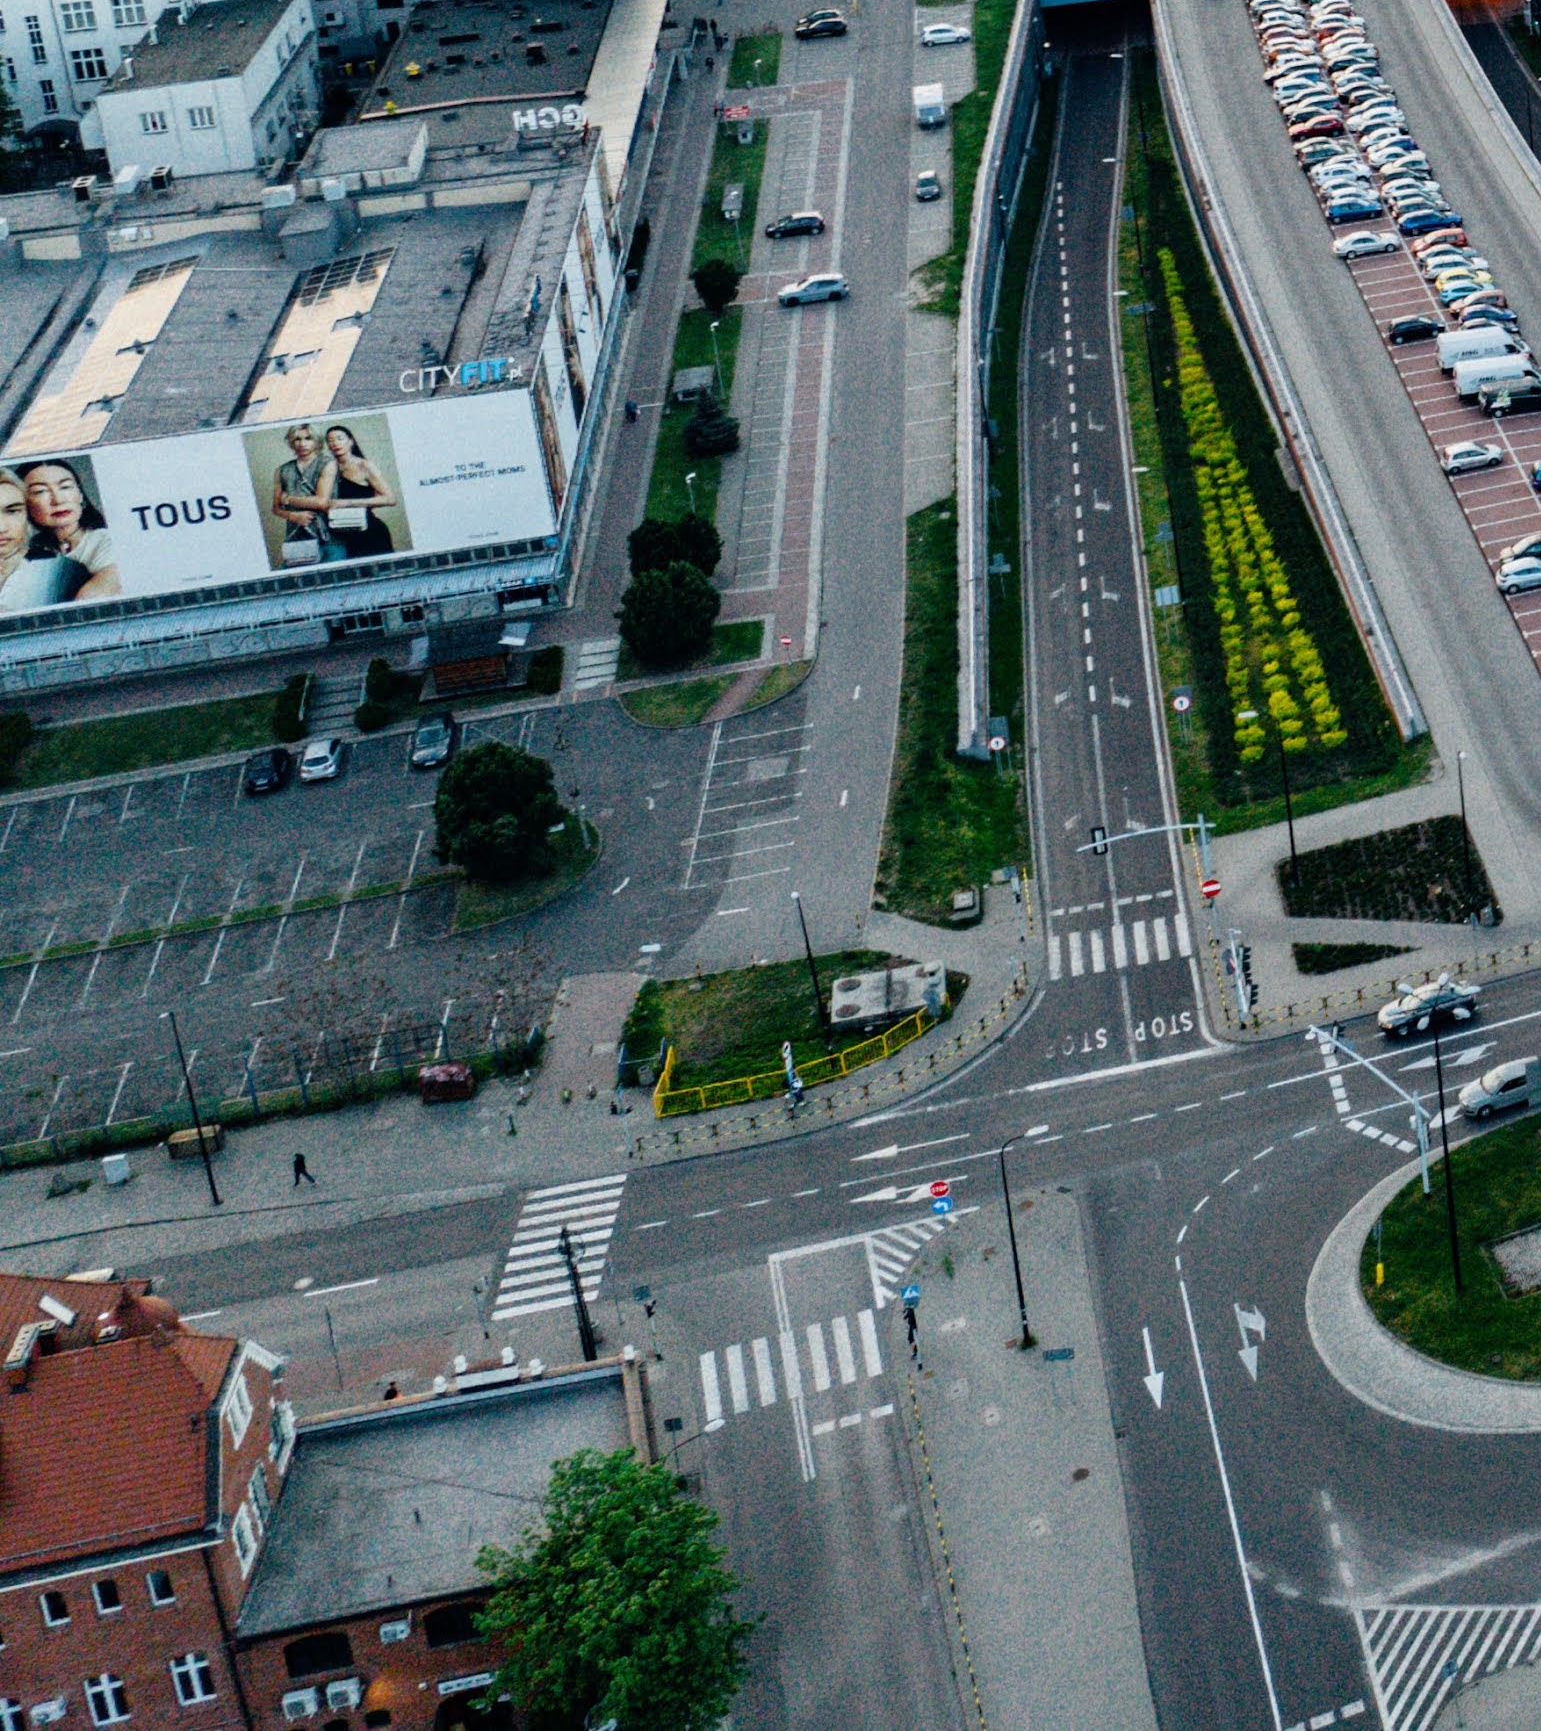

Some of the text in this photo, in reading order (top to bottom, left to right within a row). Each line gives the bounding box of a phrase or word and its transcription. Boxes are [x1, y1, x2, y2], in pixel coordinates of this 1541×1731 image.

[468, 461, 485, 469] THE
[497, 465, 526, 476] MOMS
[131, 495, 232, 530] TOUS
[1135, 1011, 1194, 1042] STOP
[930, 1184, 949, 1194] STOP
